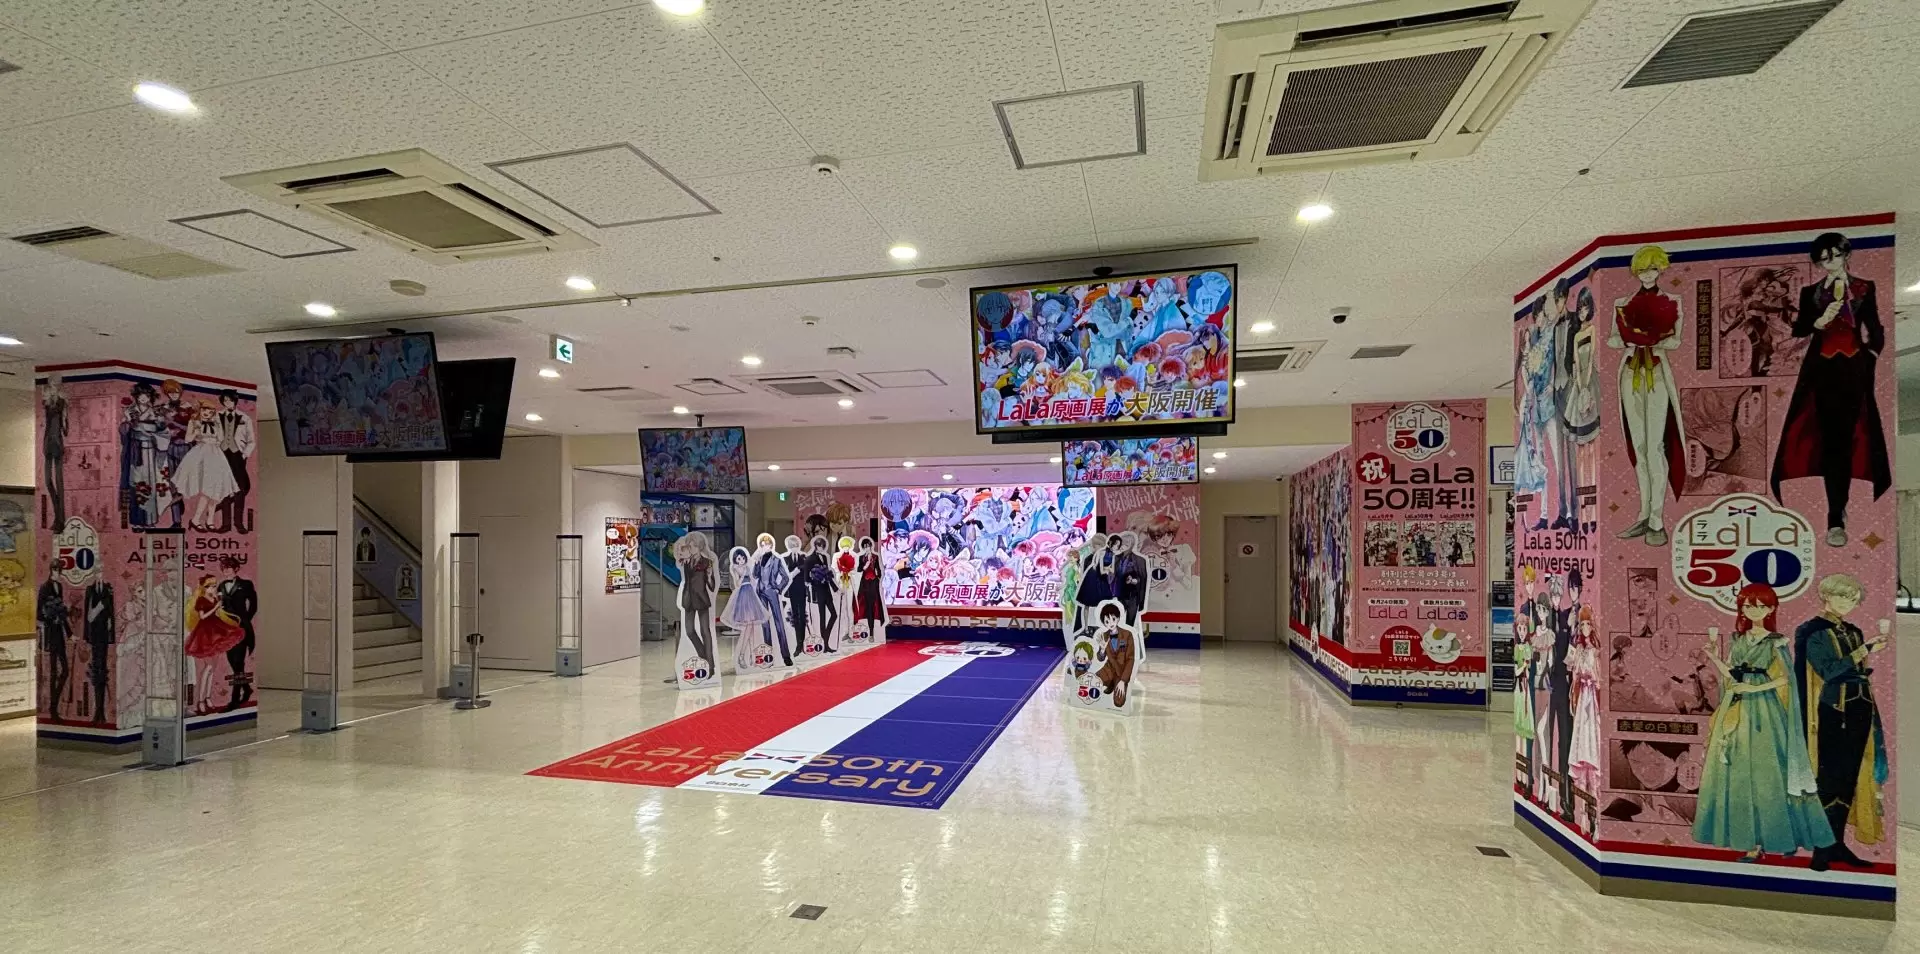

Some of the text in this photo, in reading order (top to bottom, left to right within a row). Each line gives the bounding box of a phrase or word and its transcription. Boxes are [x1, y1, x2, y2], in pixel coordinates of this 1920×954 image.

[998, 388, 1219, 421] LaLa原画展が大阪開催
[1394, 413, 1443, 430] LaLa
[1393, 429, 1445, 449] 50
[1360, 457, 1475, 485] 祝 LaLa
[1362, 487, 1476, 511] 50周年!!
[1523, 531, 1588, 551] LaLa 50th
[1689, 516, 1799, 548] LaLa
[195, 537, 240, 550] 50th
[59, 547, 95, 571] 50
[1675, 539, 1684, 570] 1976
[1803, 539, 1812, 571] 2026
[1517, 552, 1595, 580] Anniversary
[1687, 548, 1802, 588] 50
[911, 614, 961, 629] 50th
[1368, 606, 1408, 619] LaLa
[755, 654, 774, 665] 50
[683, 668, 707, 680] 50
[1358, 663, 1480, 678] LaLa 50th
[1078, 686, 1101, 699] 50
[1360, 675, 1477, 694] Anniversary
[1619, 720, 1695, 735] 赤髪の白雪姫
[611, 743, 944, 776] LaLa 50th
[579, 754, 937, 798] Anniversary
